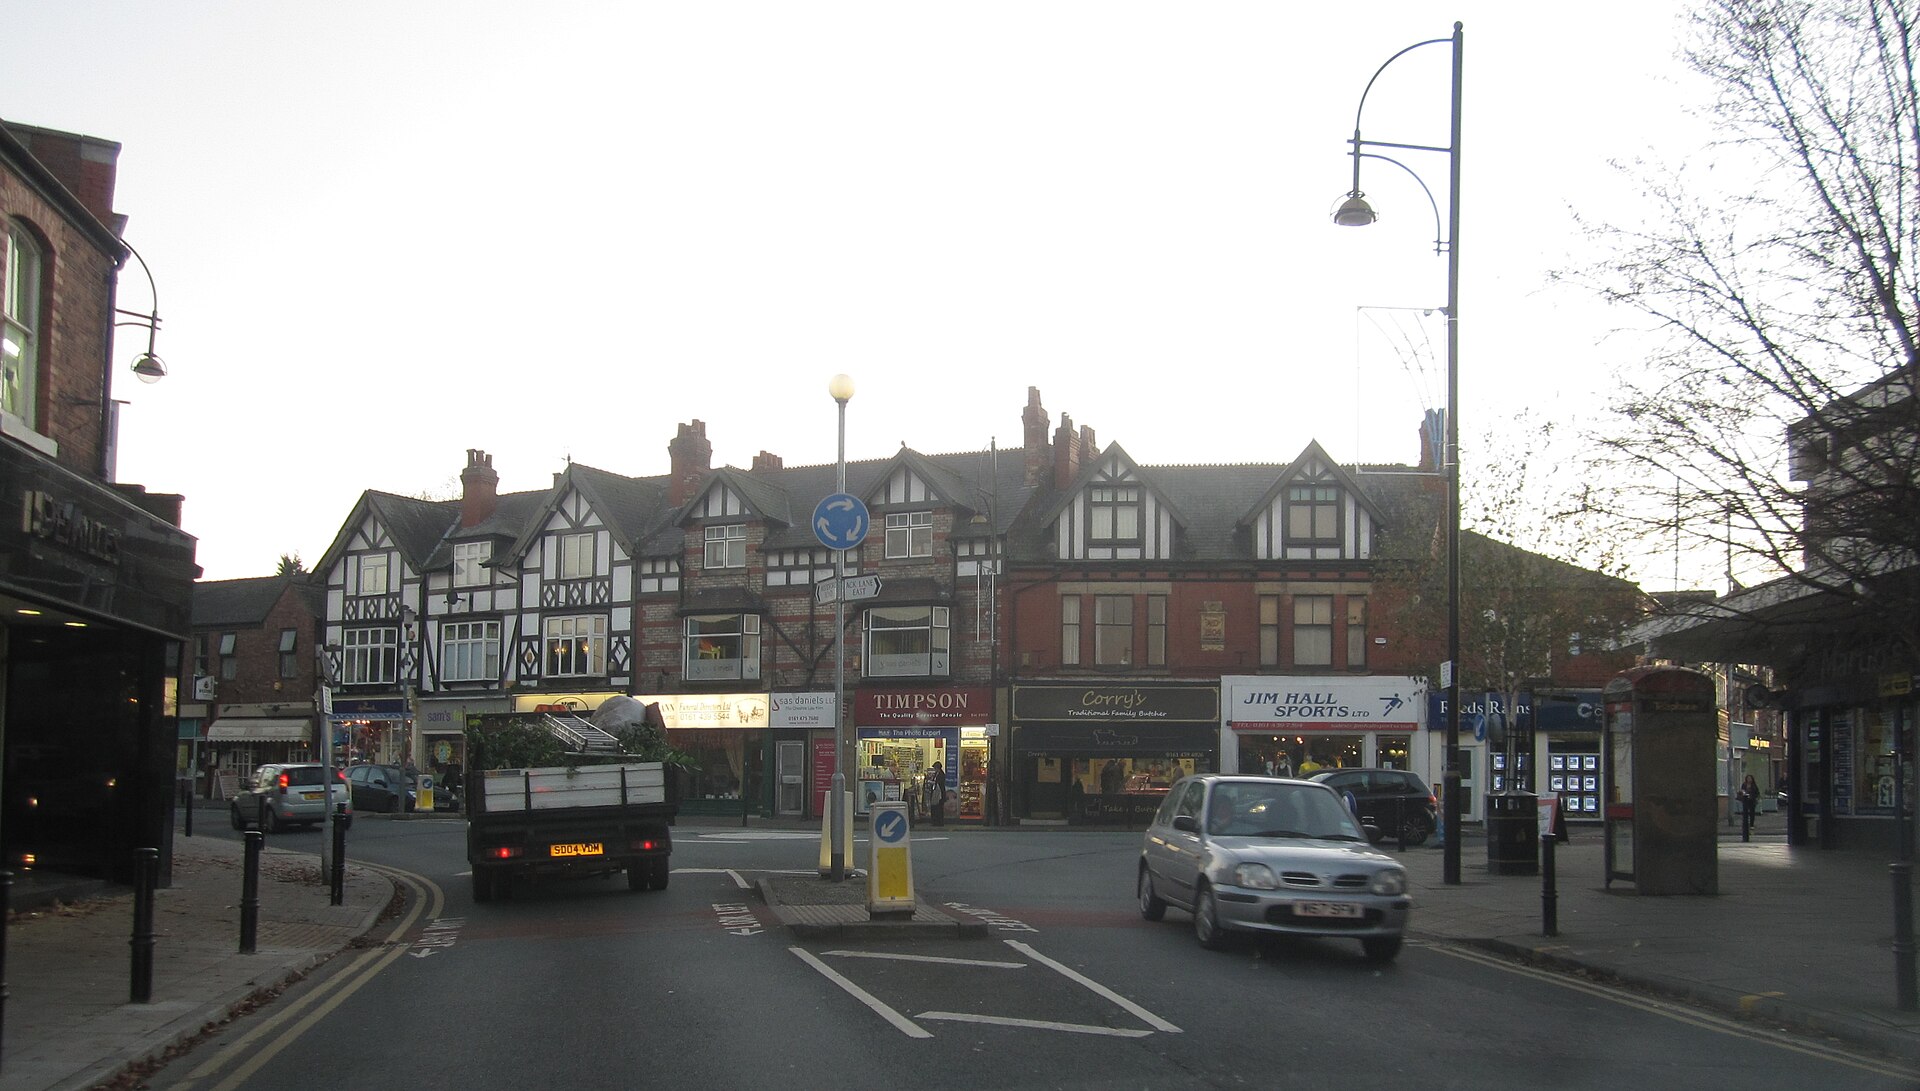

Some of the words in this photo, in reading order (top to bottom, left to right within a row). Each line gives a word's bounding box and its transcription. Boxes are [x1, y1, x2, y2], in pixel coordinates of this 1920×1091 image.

[846, 581, 857, 589] ACK
[859, 579, 873, 588] LANE
[852, 588, 866, 596] EAST
[795, 696, 824, 704] daniels
[874, 693, 968, 709] TIMPSON
[1082, 689, 1147, 709] Corry's
[1244, 693, 1279, 704] JIM
[1284, 693, 1338, 704] HALL
[427, 710, 451, 722] sam's
[1068, 709, 1110, 717] Traditional
[1111, 710, 1137, 718] Family
[1274, 706, 1349, 718] SPORTS
[554, 845, 578, 854] SD04
